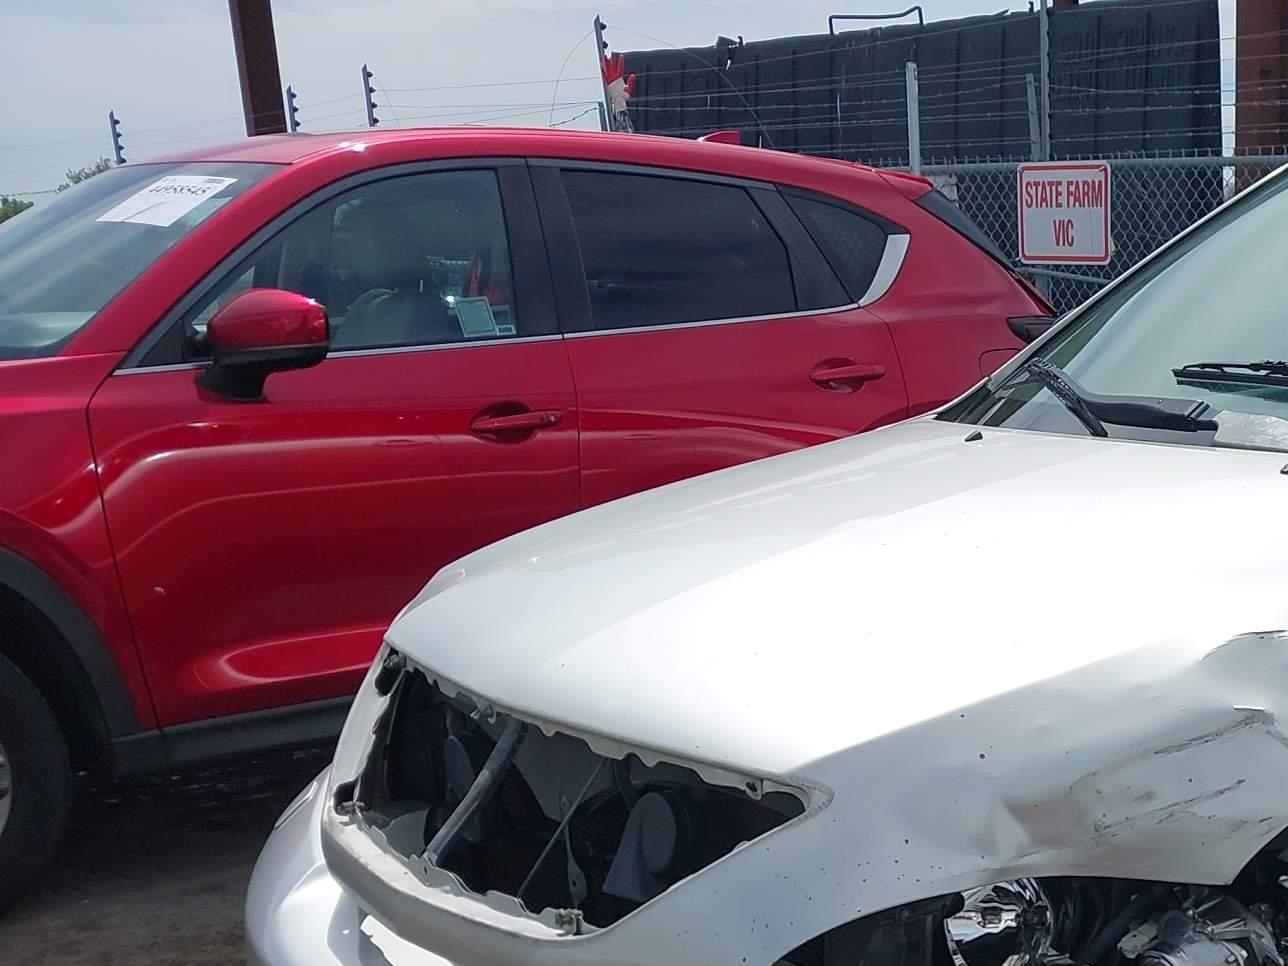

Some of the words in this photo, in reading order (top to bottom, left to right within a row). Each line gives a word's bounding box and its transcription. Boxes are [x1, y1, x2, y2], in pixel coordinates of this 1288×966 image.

[1025, 180, 1063, 208] STATE
[1066, 180, 1103, 208] FARM
[1053, 219, 1075, 247] VIC
